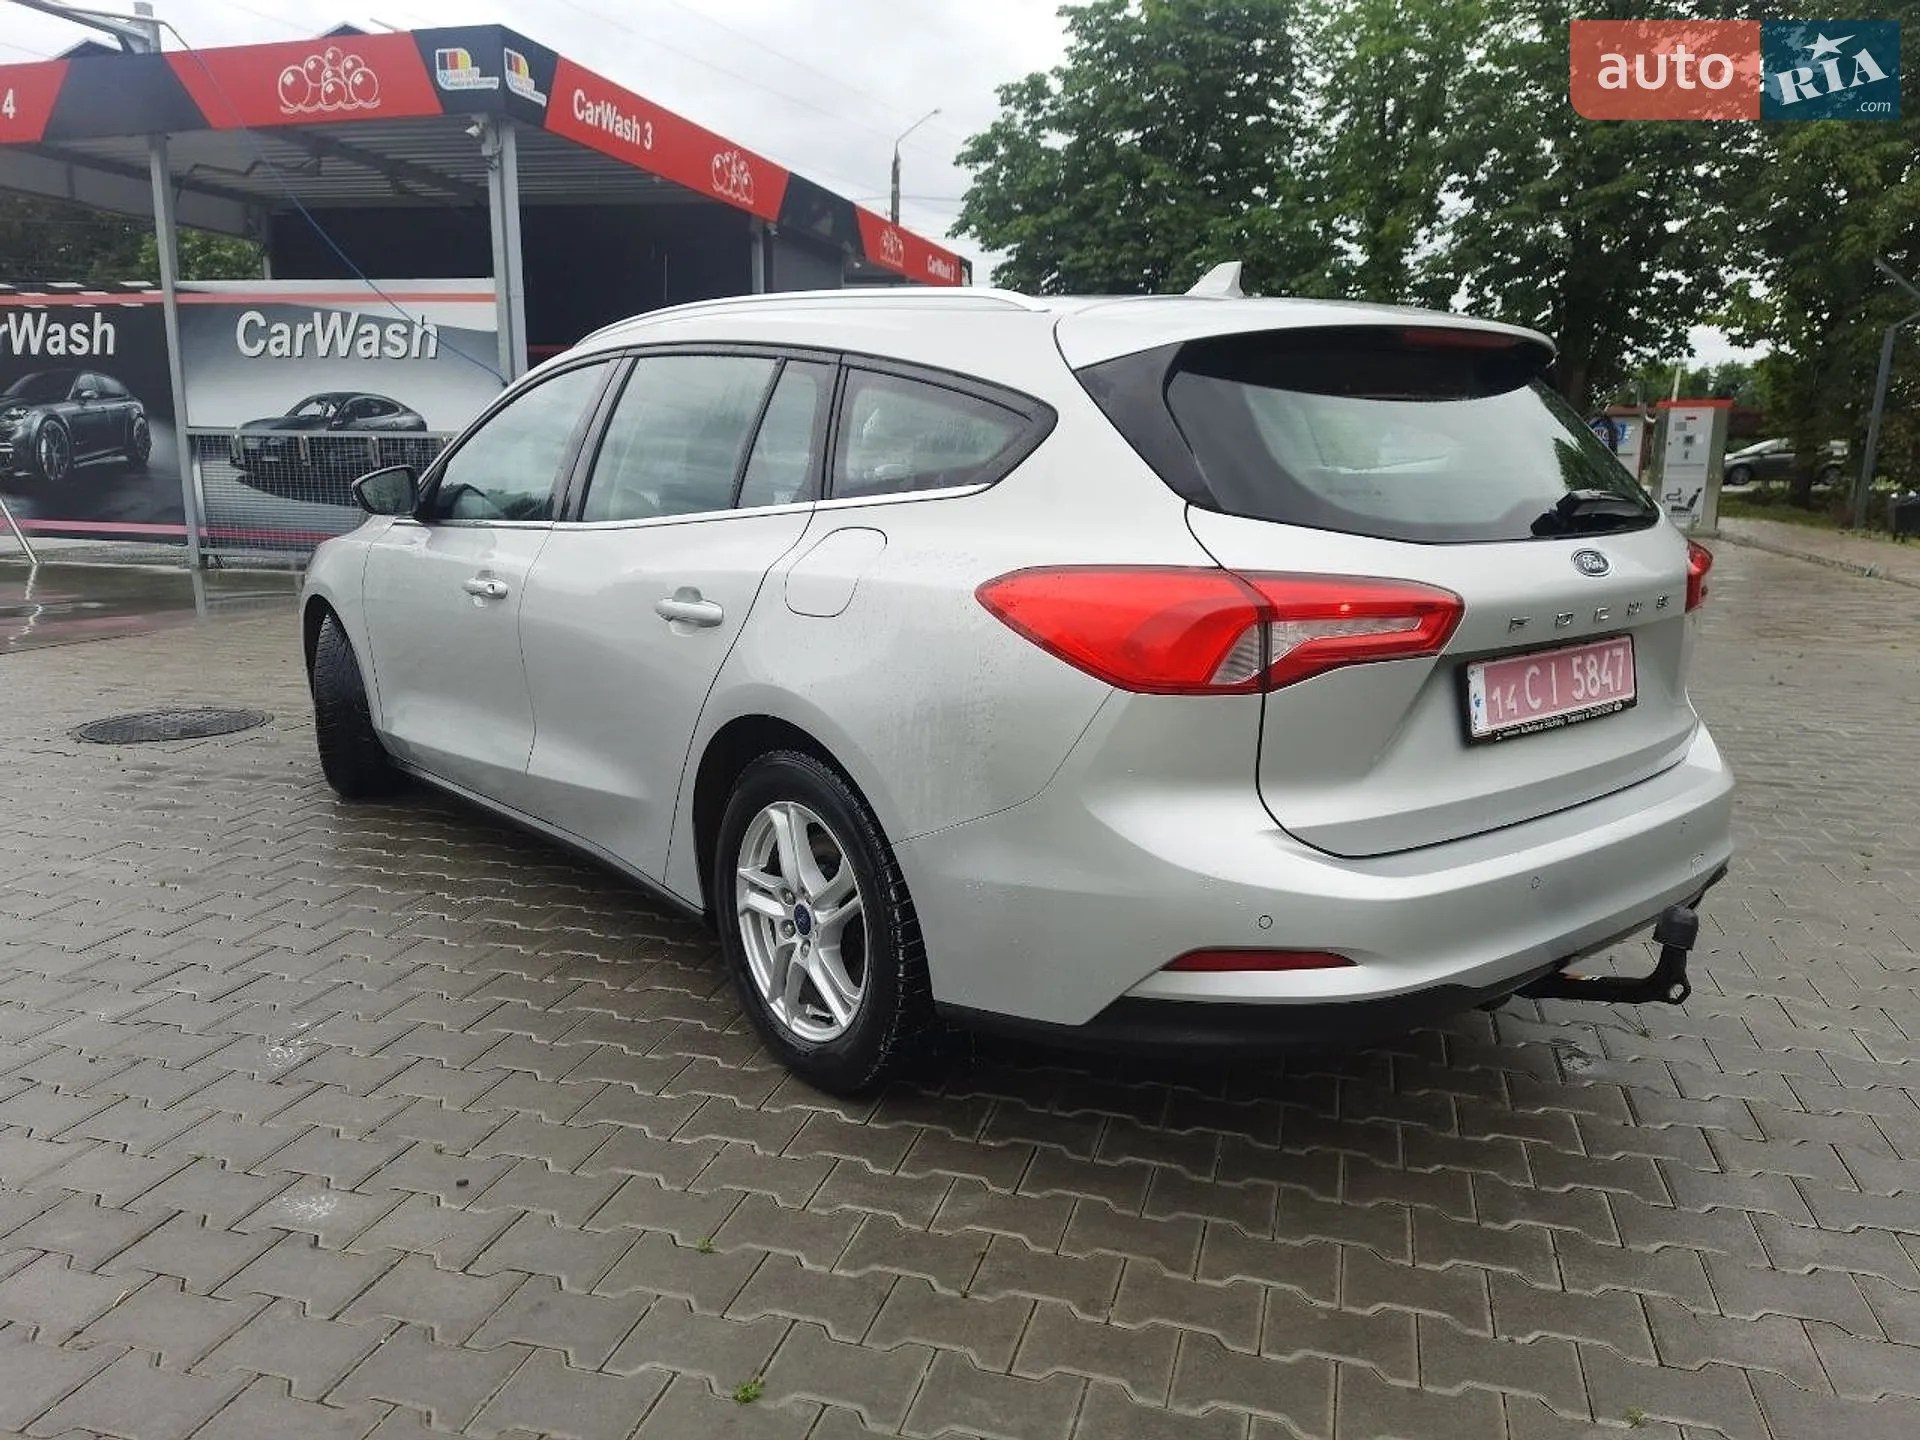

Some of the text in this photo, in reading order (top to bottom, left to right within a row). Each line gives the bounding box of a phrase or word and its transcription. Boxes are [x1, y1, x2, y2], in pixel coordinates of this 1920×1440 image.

[2, 88, 16, 119] 4
[573, 88, 641, 145] CarWash
[644, 121, 653, 150] 3
[236, 310, 440, 360] CarWash
